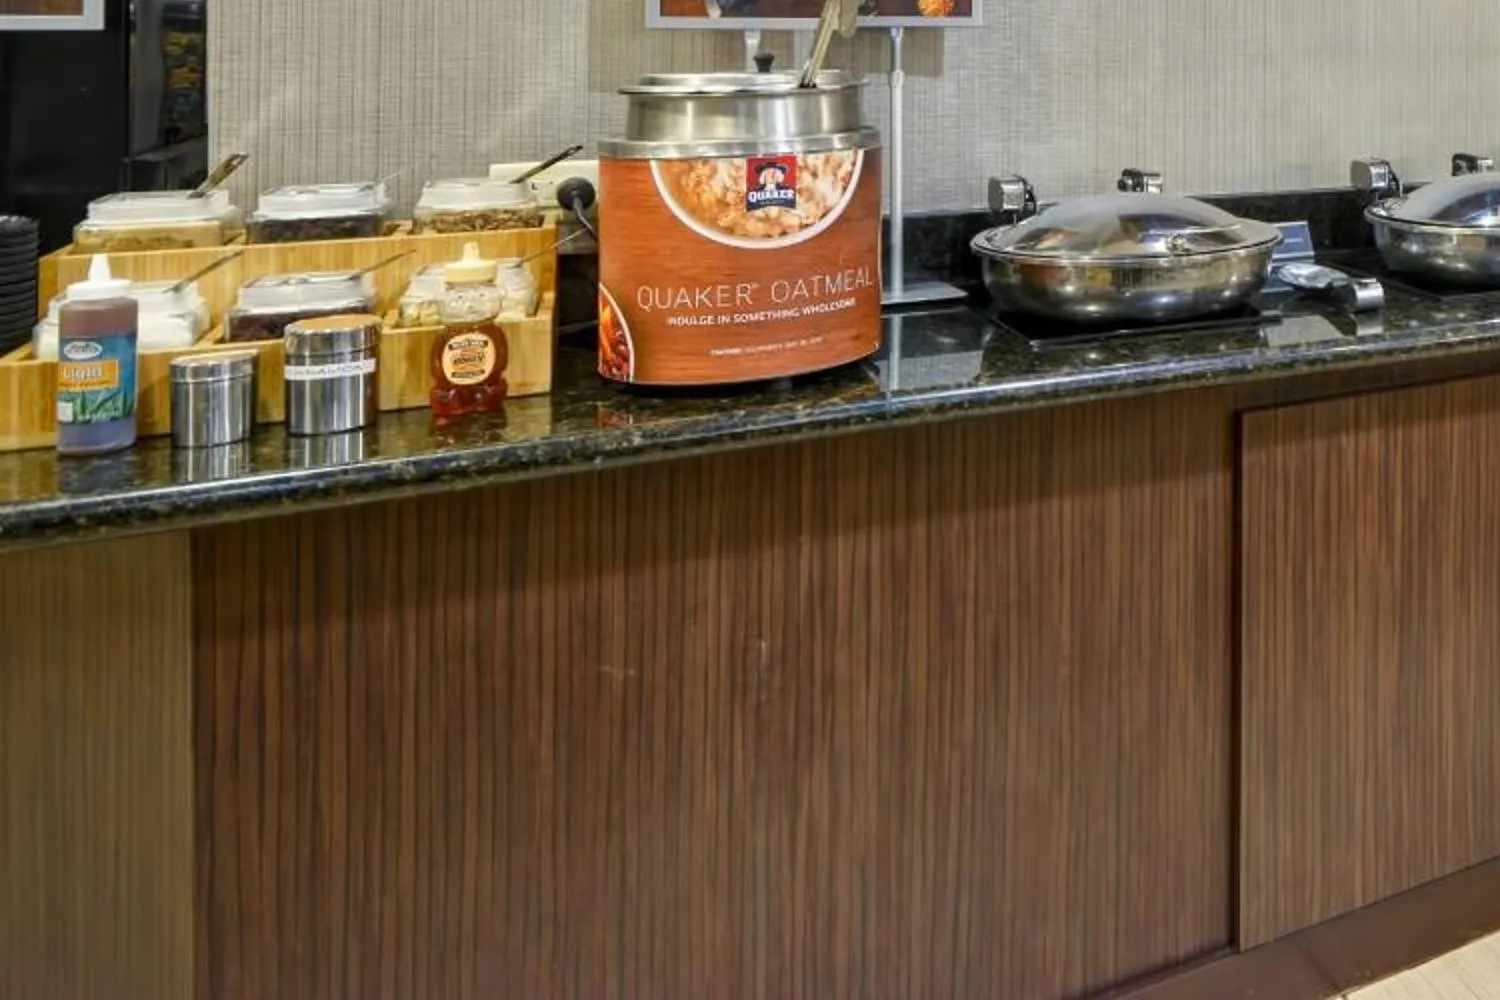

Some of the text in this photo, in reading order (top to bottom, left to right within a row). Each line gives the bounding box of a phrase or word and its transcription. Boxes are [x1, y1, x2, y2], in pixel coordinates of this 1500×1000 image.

[748, 189, 795, 203] QUAKER
[770, 267, 873, 303] OATMEAL
[666, 297, 857, 327] INDULGE IN SOMETHING WHOLESOME
